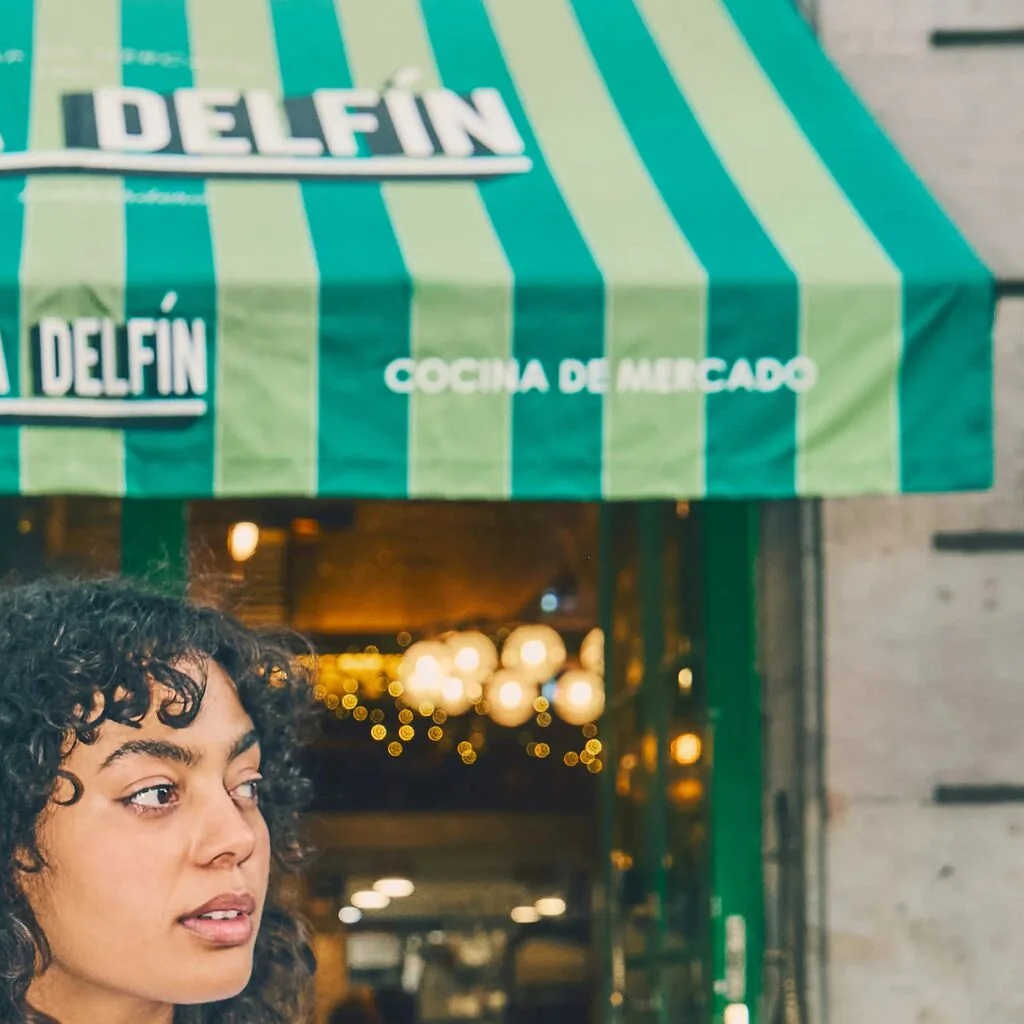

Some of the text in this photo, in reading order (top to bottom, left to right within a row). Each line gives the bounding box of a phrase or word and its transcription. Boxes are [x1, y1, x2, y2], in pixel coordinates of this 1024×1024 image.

[93, 66, 525, 157] DELFÍN
[39, 291, 208, 397] DELFÍN
[384, 357, 819, 394] COCINA DE MERCADO
